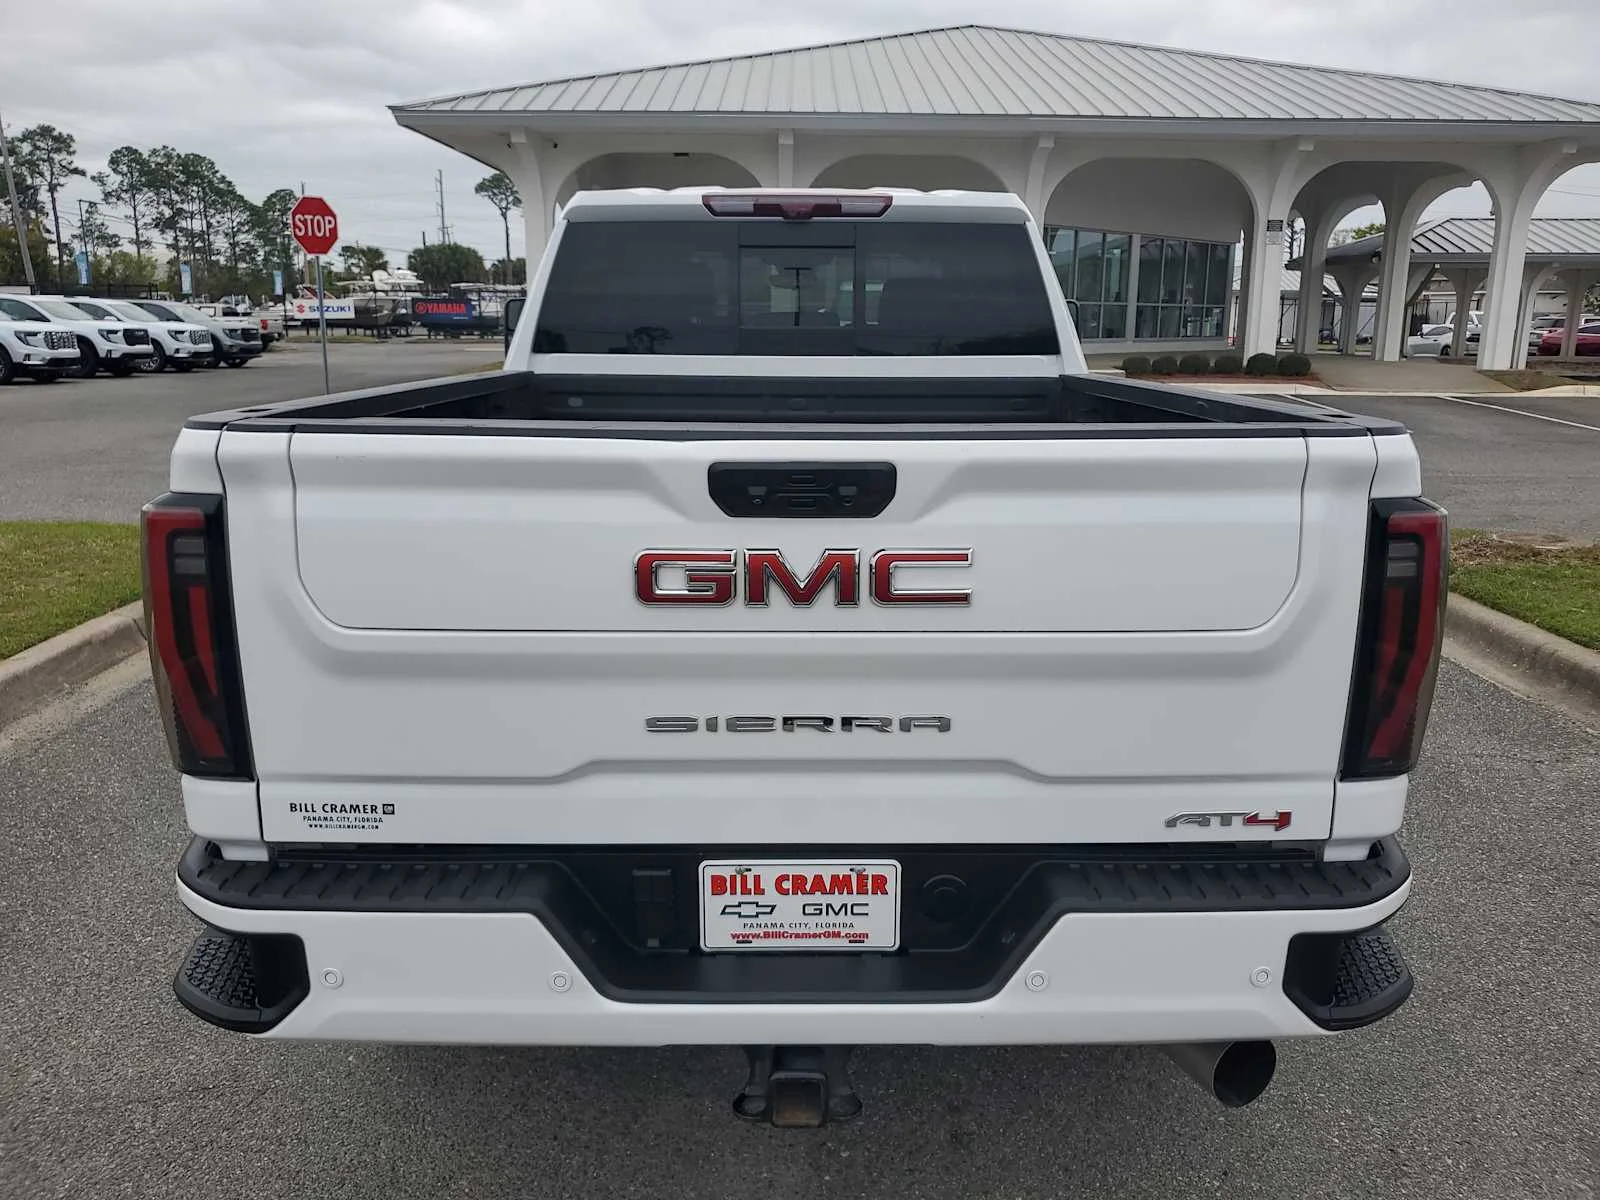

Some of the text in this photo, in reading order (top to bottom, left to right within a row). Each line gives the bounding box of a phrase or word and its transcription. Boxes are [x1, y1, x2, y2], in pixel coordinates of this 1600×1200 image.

[295, 214, 335, 237] STOP
[428, 303, 466, 314] YAMAHA
[634, 548, 974, 608] GMC
[645, 715, 951, 733] SIERRA
[289, 803, 379, 815] BILL CRAMER
[336, 816, 353, 824] CITY,
[1164, 810, 1293, 832] AT4
[710, 874, 889, 896] BILL CRAMER
[802, 903, 869, 916] GMC
[788, 922, 811, 930] CITY,
[730, 930, 869, 940] www.BillCramerGM.com
